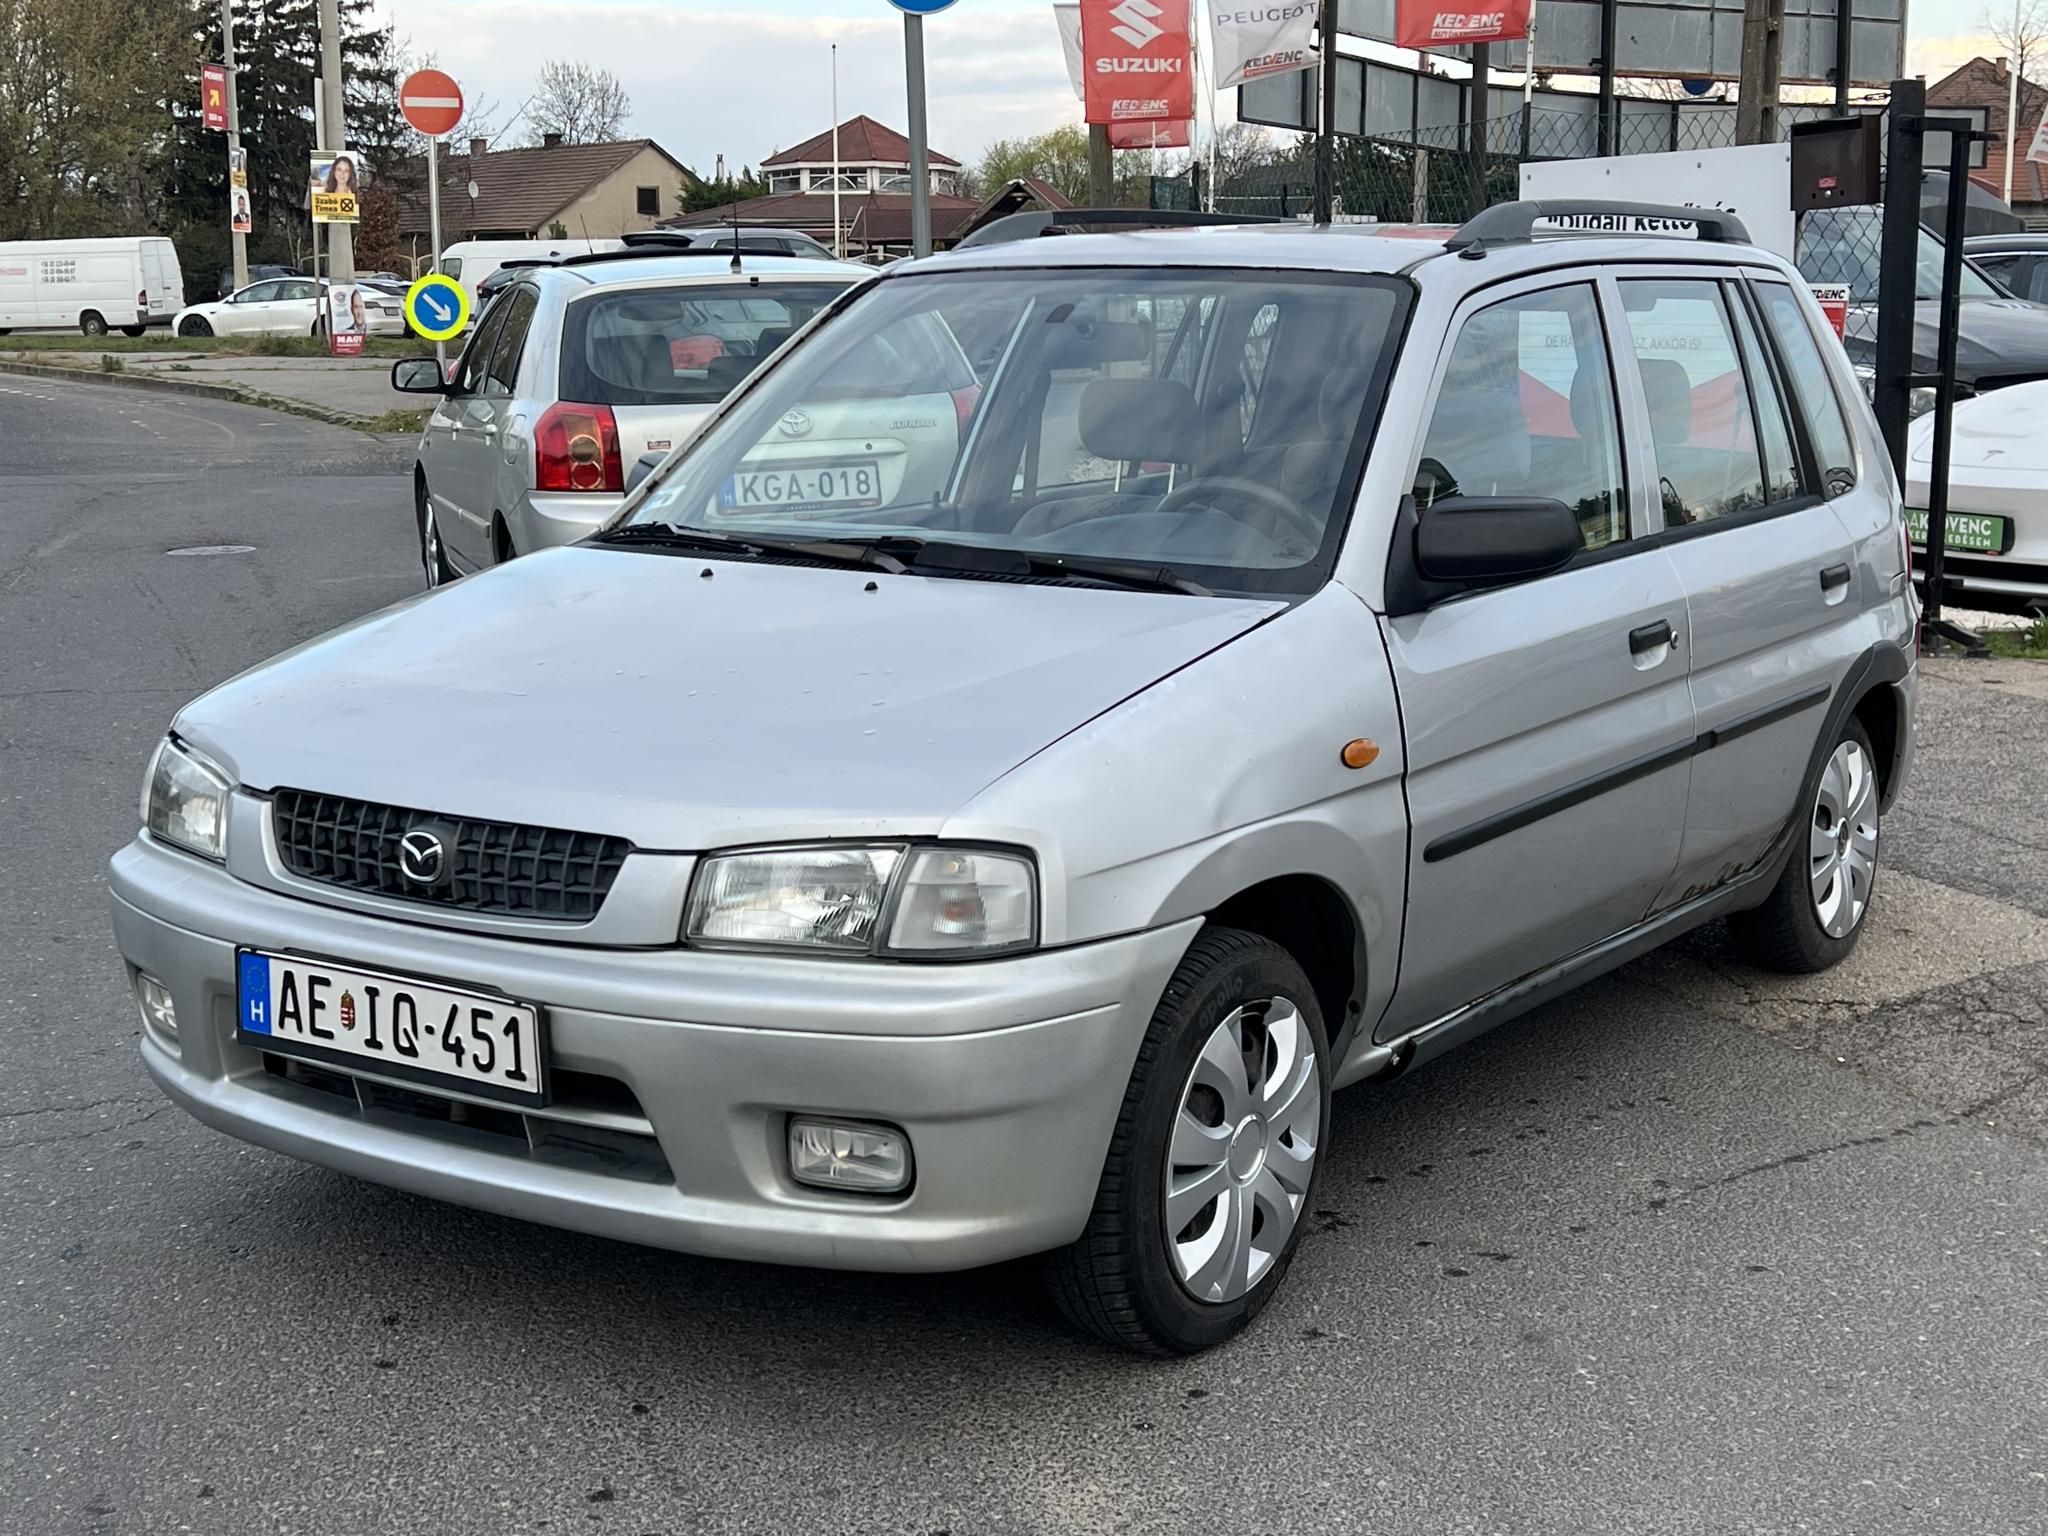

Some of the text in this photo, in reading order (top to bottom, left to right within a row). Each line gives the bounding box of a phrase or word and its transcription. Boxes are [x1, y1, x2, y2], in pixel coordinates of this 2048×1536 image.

[1217, 2, 1316, 26] PEUGEOT
[1096, 58, 1182, 73] SUZUKI
[1243, 50, 1304, 70] KEDVENC
[1812, 289, 1846, 299] DVENC
[1545, 336, 1558, 348] DE
[1650, 337, 1688, 350] AKKOR
[741, 469, 872, 503] KGA-018
[1920, 513, 1992, 536] KVENC
[1198, 974, 1244, 1030] apollo
[250, 969, 527, 1082] H AE IQ-451
